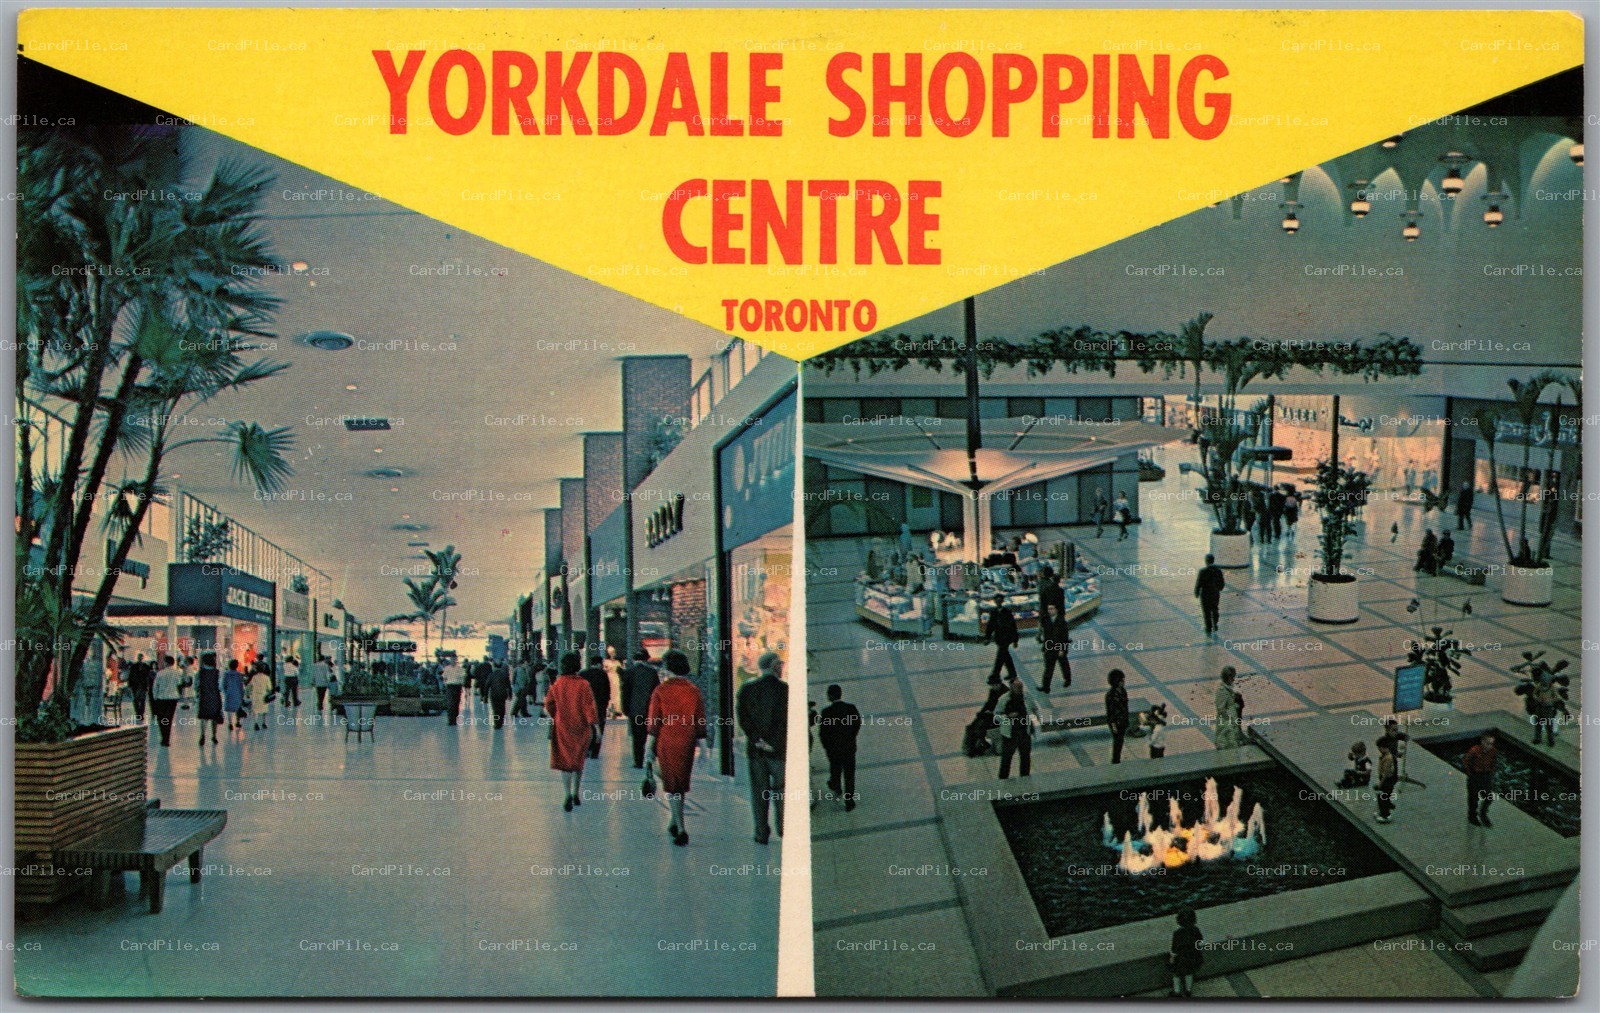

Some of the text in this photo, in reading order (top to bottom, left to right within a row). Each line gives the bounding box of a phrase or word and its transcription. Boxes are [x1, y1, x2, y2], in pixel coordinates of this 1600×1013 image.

[372, 49, 1232, 140] YORKDALE SHOPPING
[662, 178, 942, 266] CENTRE
[722, 299, 877, 333] TORONTO
